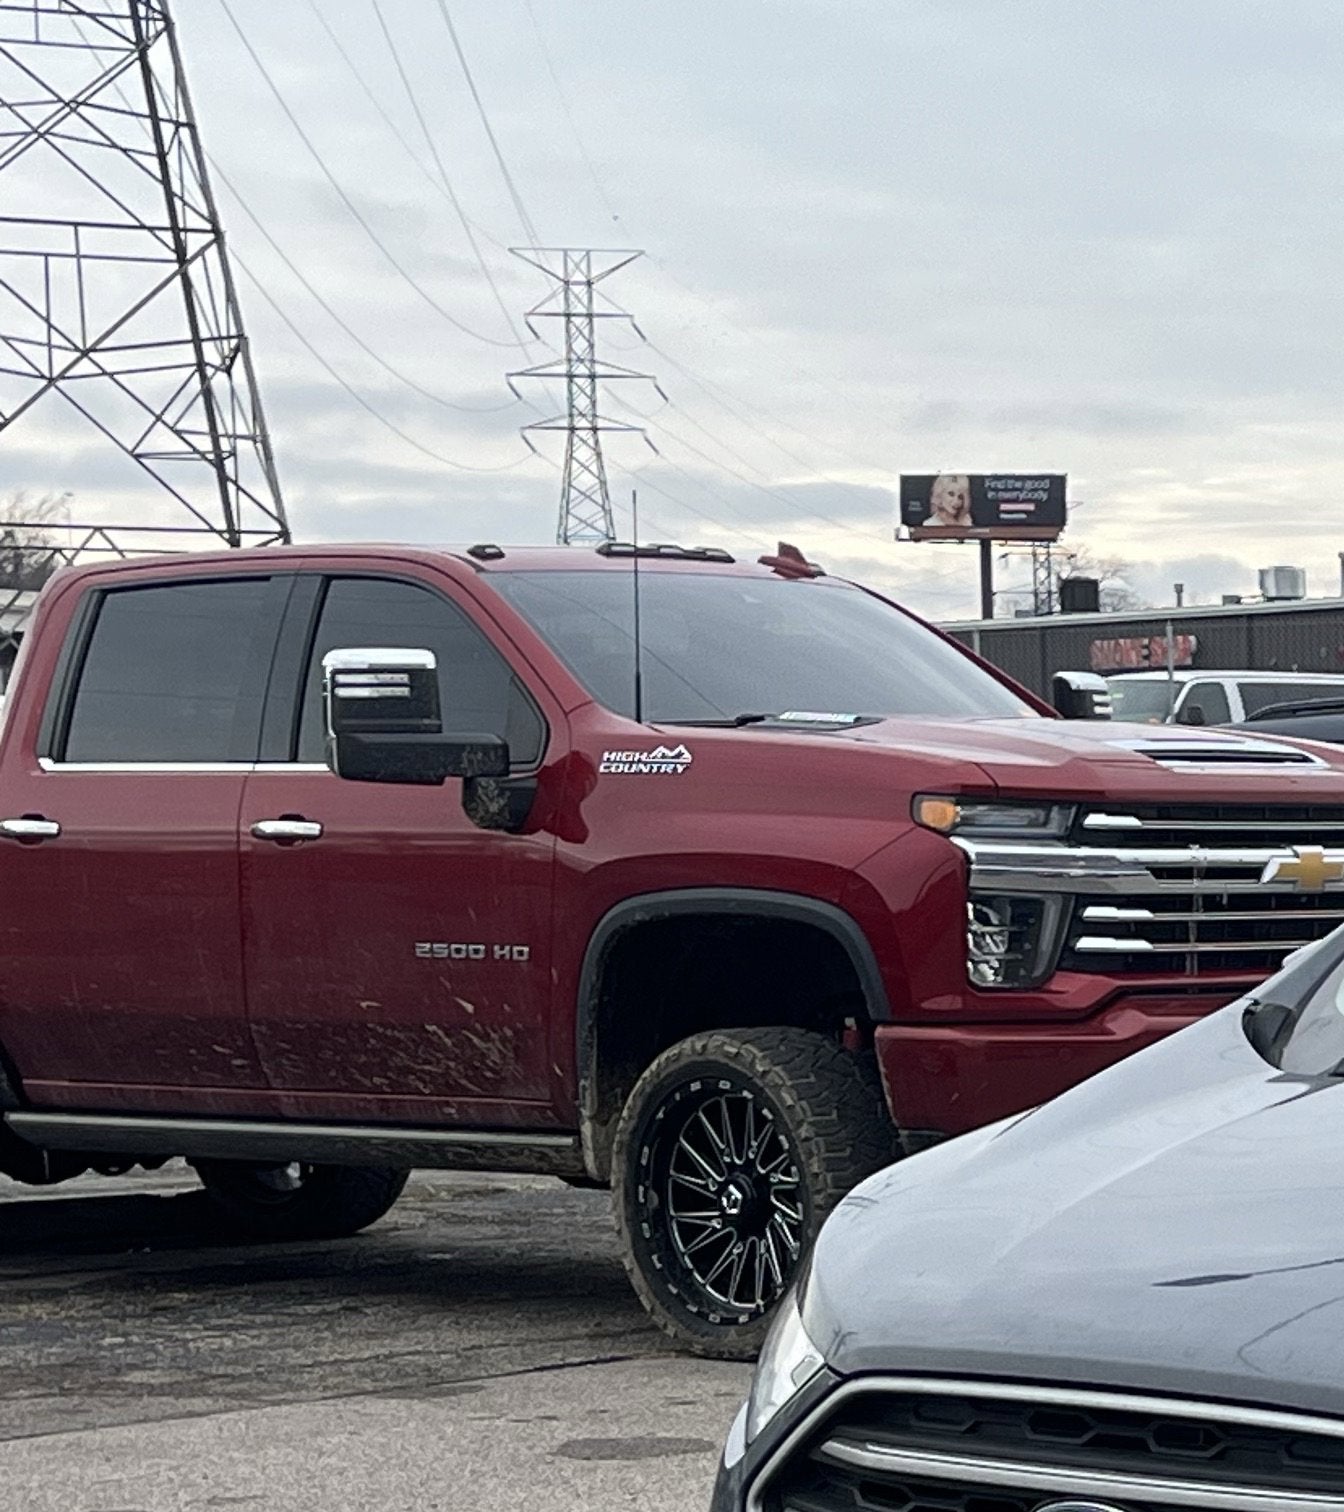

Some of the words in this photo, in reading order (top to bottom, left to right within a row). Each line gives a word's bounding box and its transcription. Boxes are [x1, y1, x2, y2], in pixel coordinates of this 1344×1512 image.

[1024, 479, 1050, 491] good
[998, 490, 1049, 502] everybody
[603, 751, 650, 762] HIGH
[599, 762, 688, 774] COUNTRY
[415, 942, 486, 960] 2500
[493, 944, 530, 961] HD
